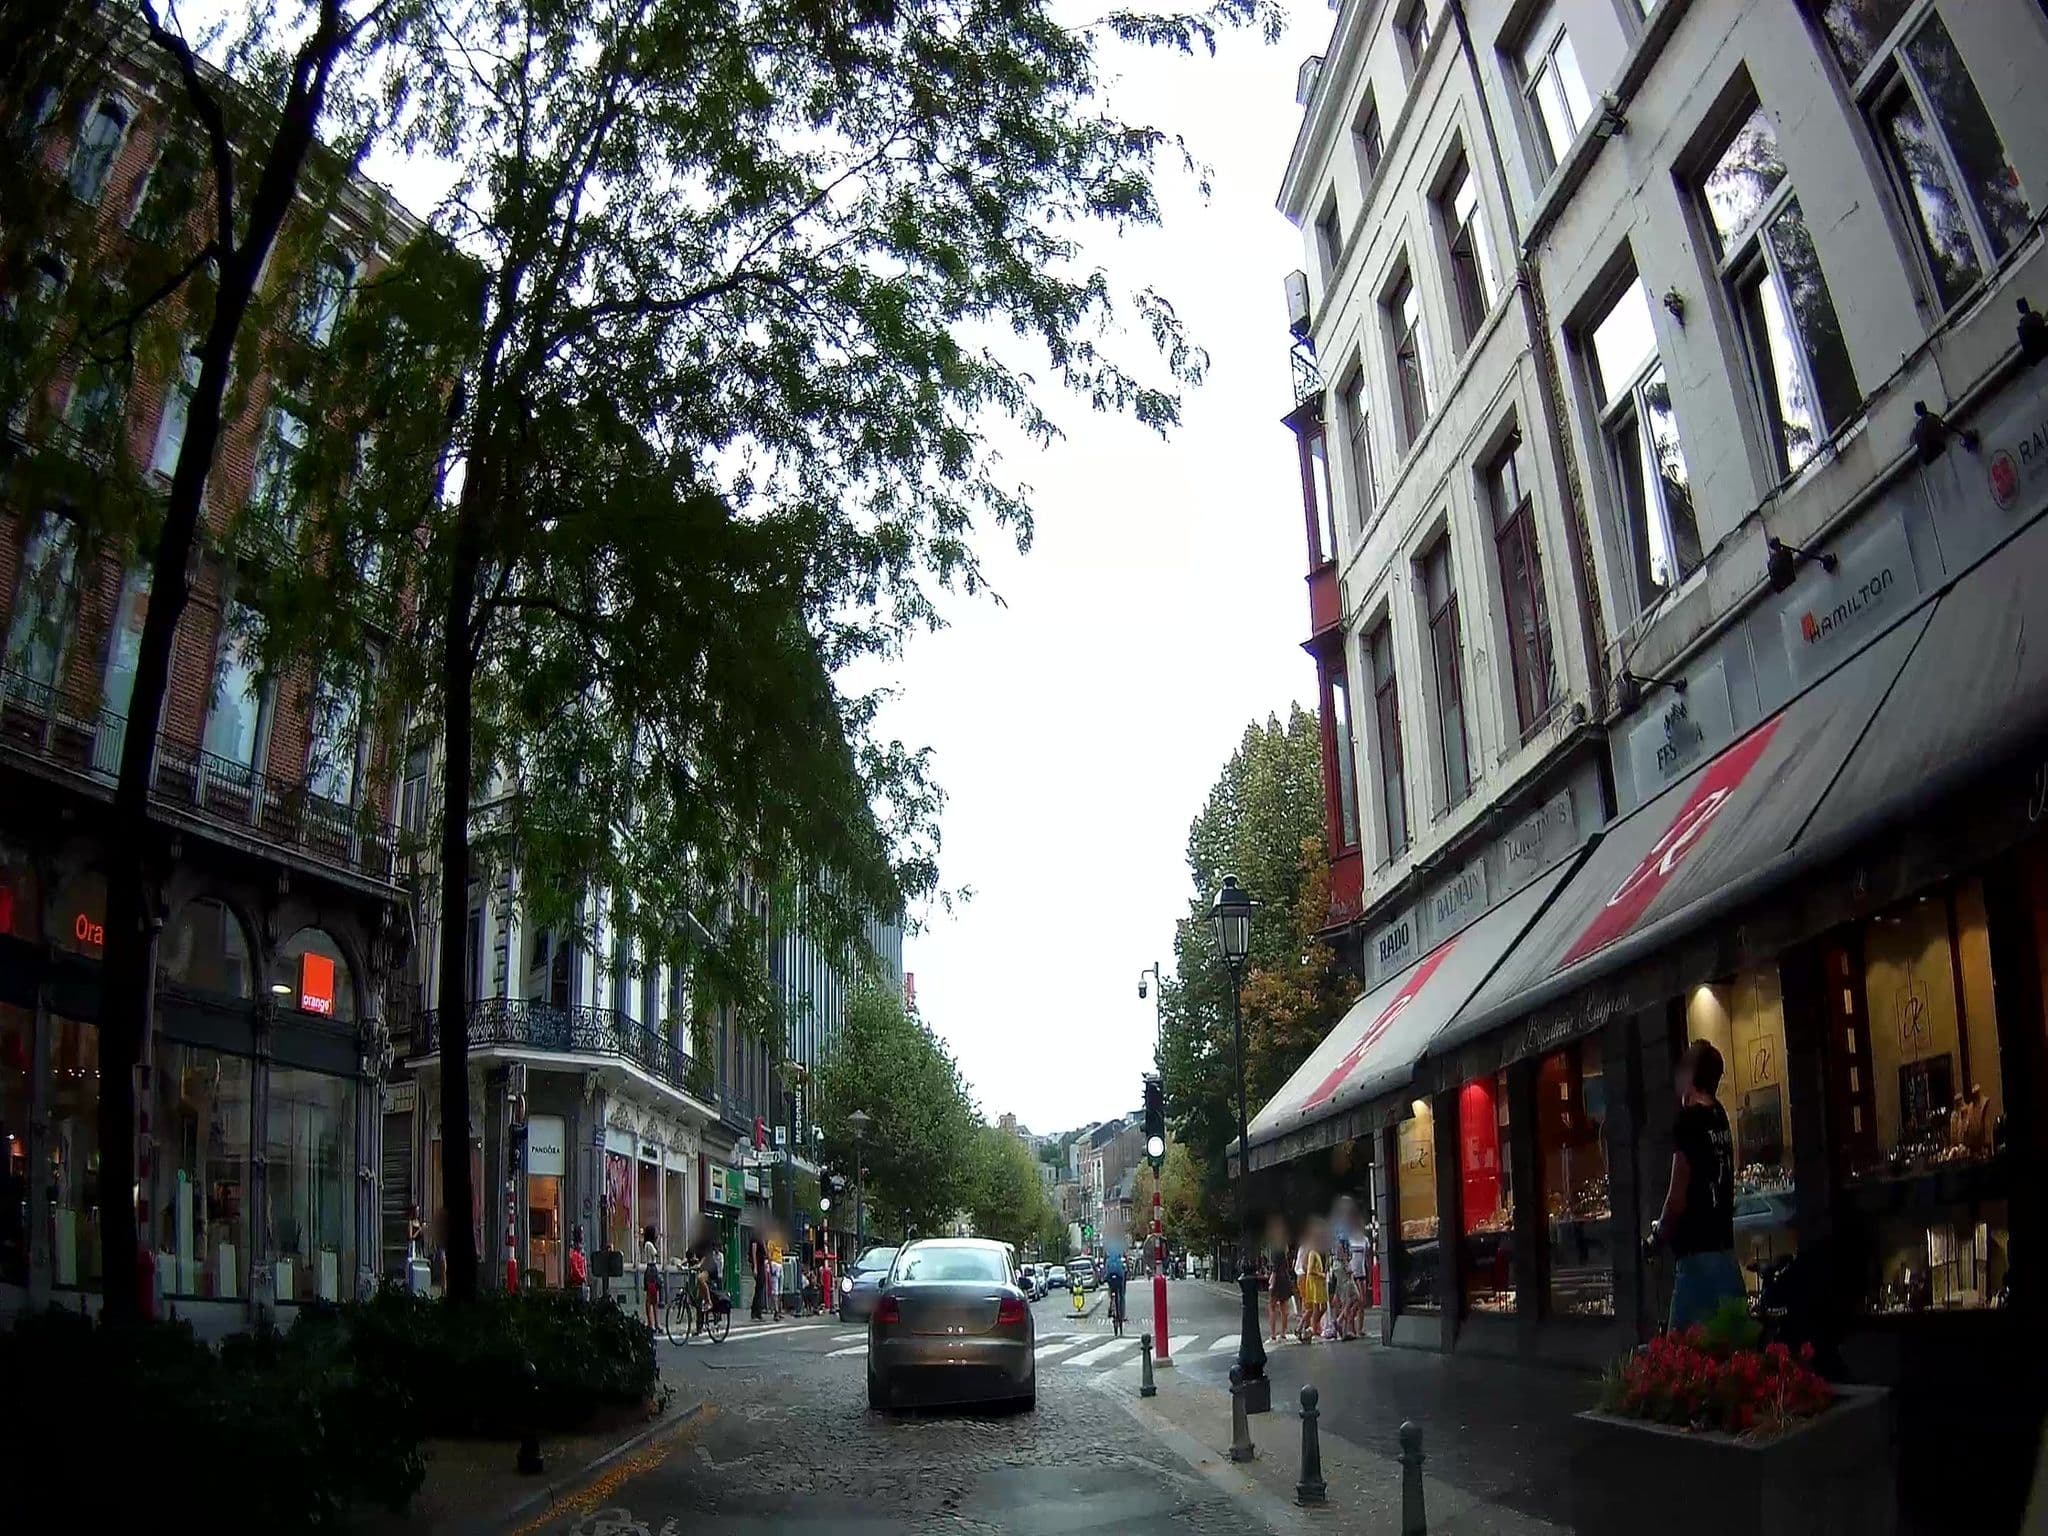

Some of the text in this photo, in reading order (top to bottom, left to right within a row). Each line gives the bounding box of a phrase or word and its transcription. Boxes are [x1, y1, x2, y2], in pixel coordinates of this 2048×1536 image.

[1809, 567, 1893, 645] HAMILTON
[1437, 870, 1479, 922] BALMAIN
[1380, 922, 1409, 963] RADO
[303, 994, 331, 1013] orange
